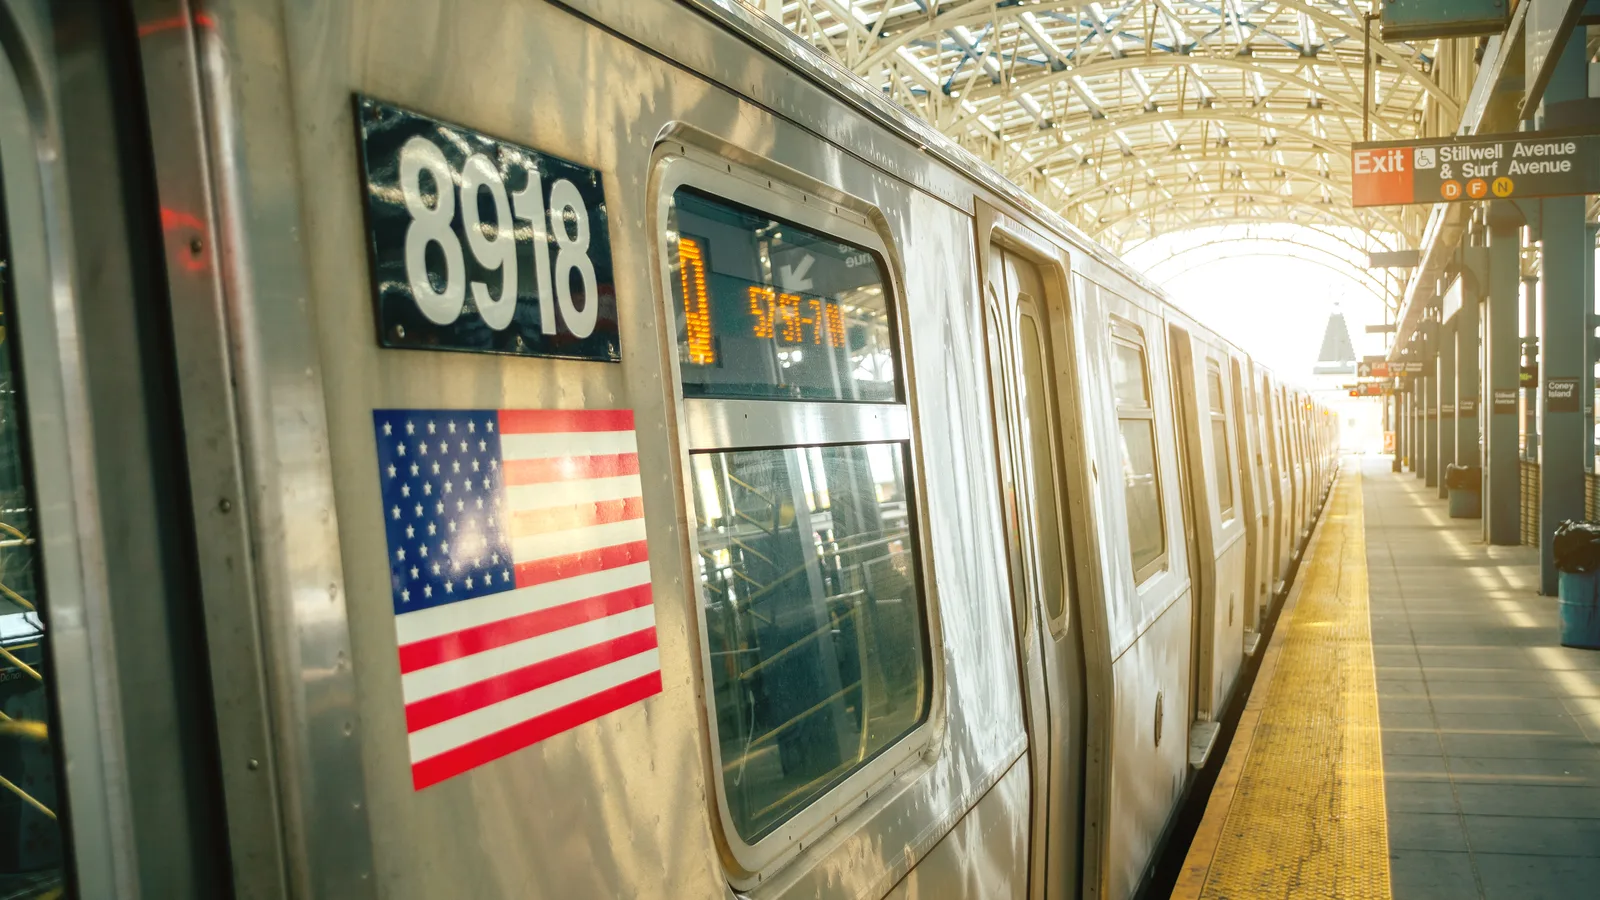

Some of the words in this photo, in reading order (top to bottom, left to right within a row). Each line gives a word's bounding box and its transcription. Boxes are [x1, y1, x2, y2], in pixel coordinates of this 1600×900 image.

[1354, 150, 1404, 174] Exit
[1440, 143, 1503, 163] Stillwell
[1512, 142, 1576, 158] Avenue
[1440, 163, 1453, 180] &
[1462, 161, 1498, 178] Surf
[1508, 159, 1571, 176] Avenue
[399, 135, 599, 339] 8918
[1548, 390, 1571, 398] Island
[1549, 381, 1574, 390] Coney
